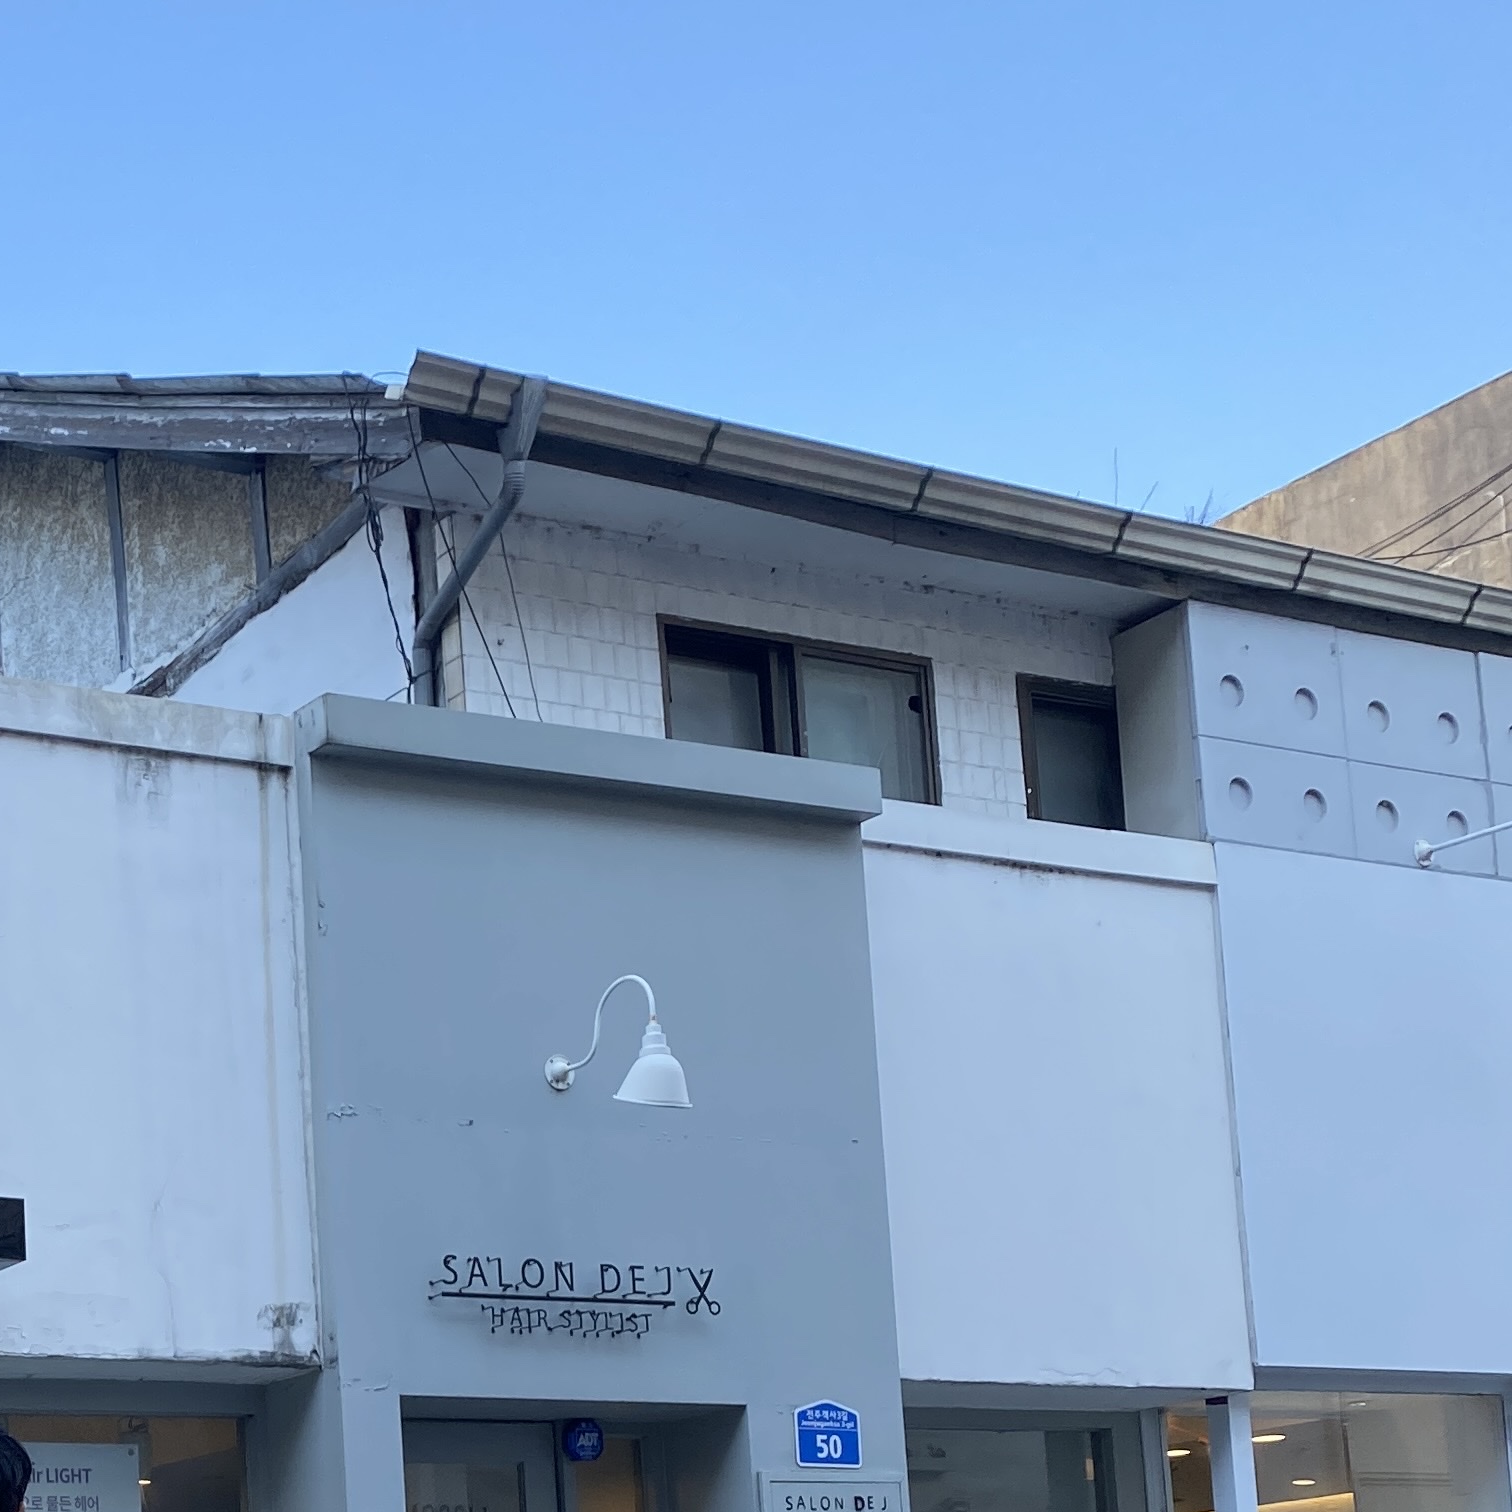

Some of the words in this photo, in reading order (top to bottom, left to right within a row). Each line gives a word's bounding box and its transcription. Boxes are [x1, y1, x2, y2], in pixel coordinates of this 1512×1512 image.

[442, 1255, 574, 1293] SALON
[486, 1306, 551, 1333] HAIR
[558, 1309, 653, 1337] STYLIST
[576, 1432, 599, 1447] ADT
[816, 1434, 842, 1459] 50
[46, 1467, 92, 1484] LIGHT
[47, 1496, 72, 1512] 물든
[74, 1496, 100, 1512] 헤어
[785, 1496, 844, 1511] SALON
[854, 1496, 874, 1512] DE
[881, 1496, 888, 1511] J
